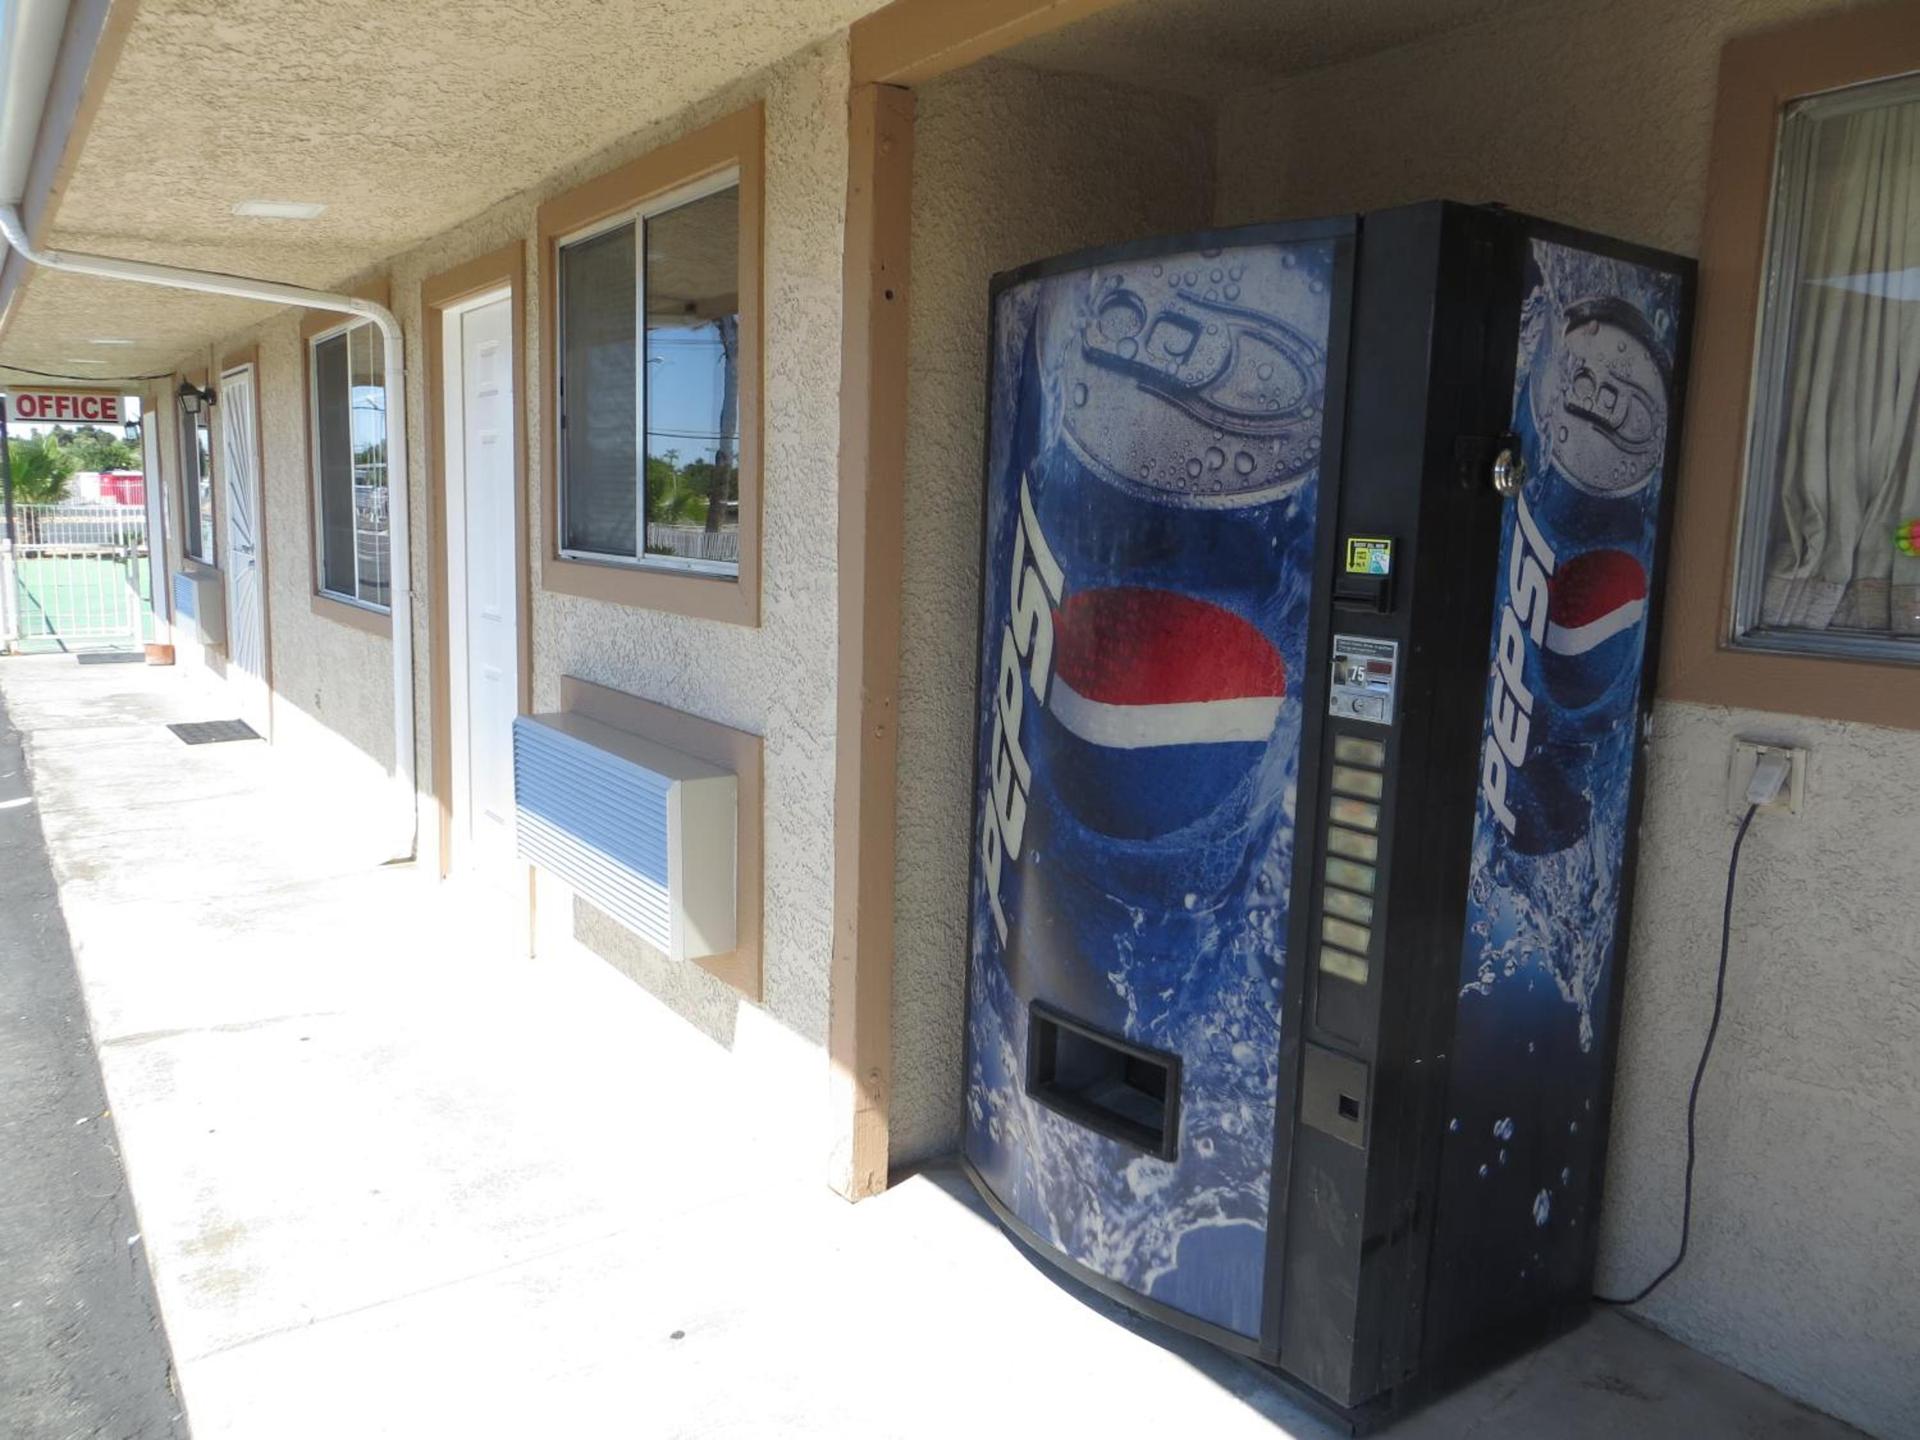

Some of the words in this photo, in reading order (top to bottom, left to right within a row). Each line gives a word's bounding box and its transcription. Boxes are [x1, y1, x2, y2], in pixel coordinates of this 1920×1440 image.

[16, 394, 118, 419] OFFICE
[983, 471, 1065, 949] PEPSI
[1482, 490, 1555, 835] PEPSI
